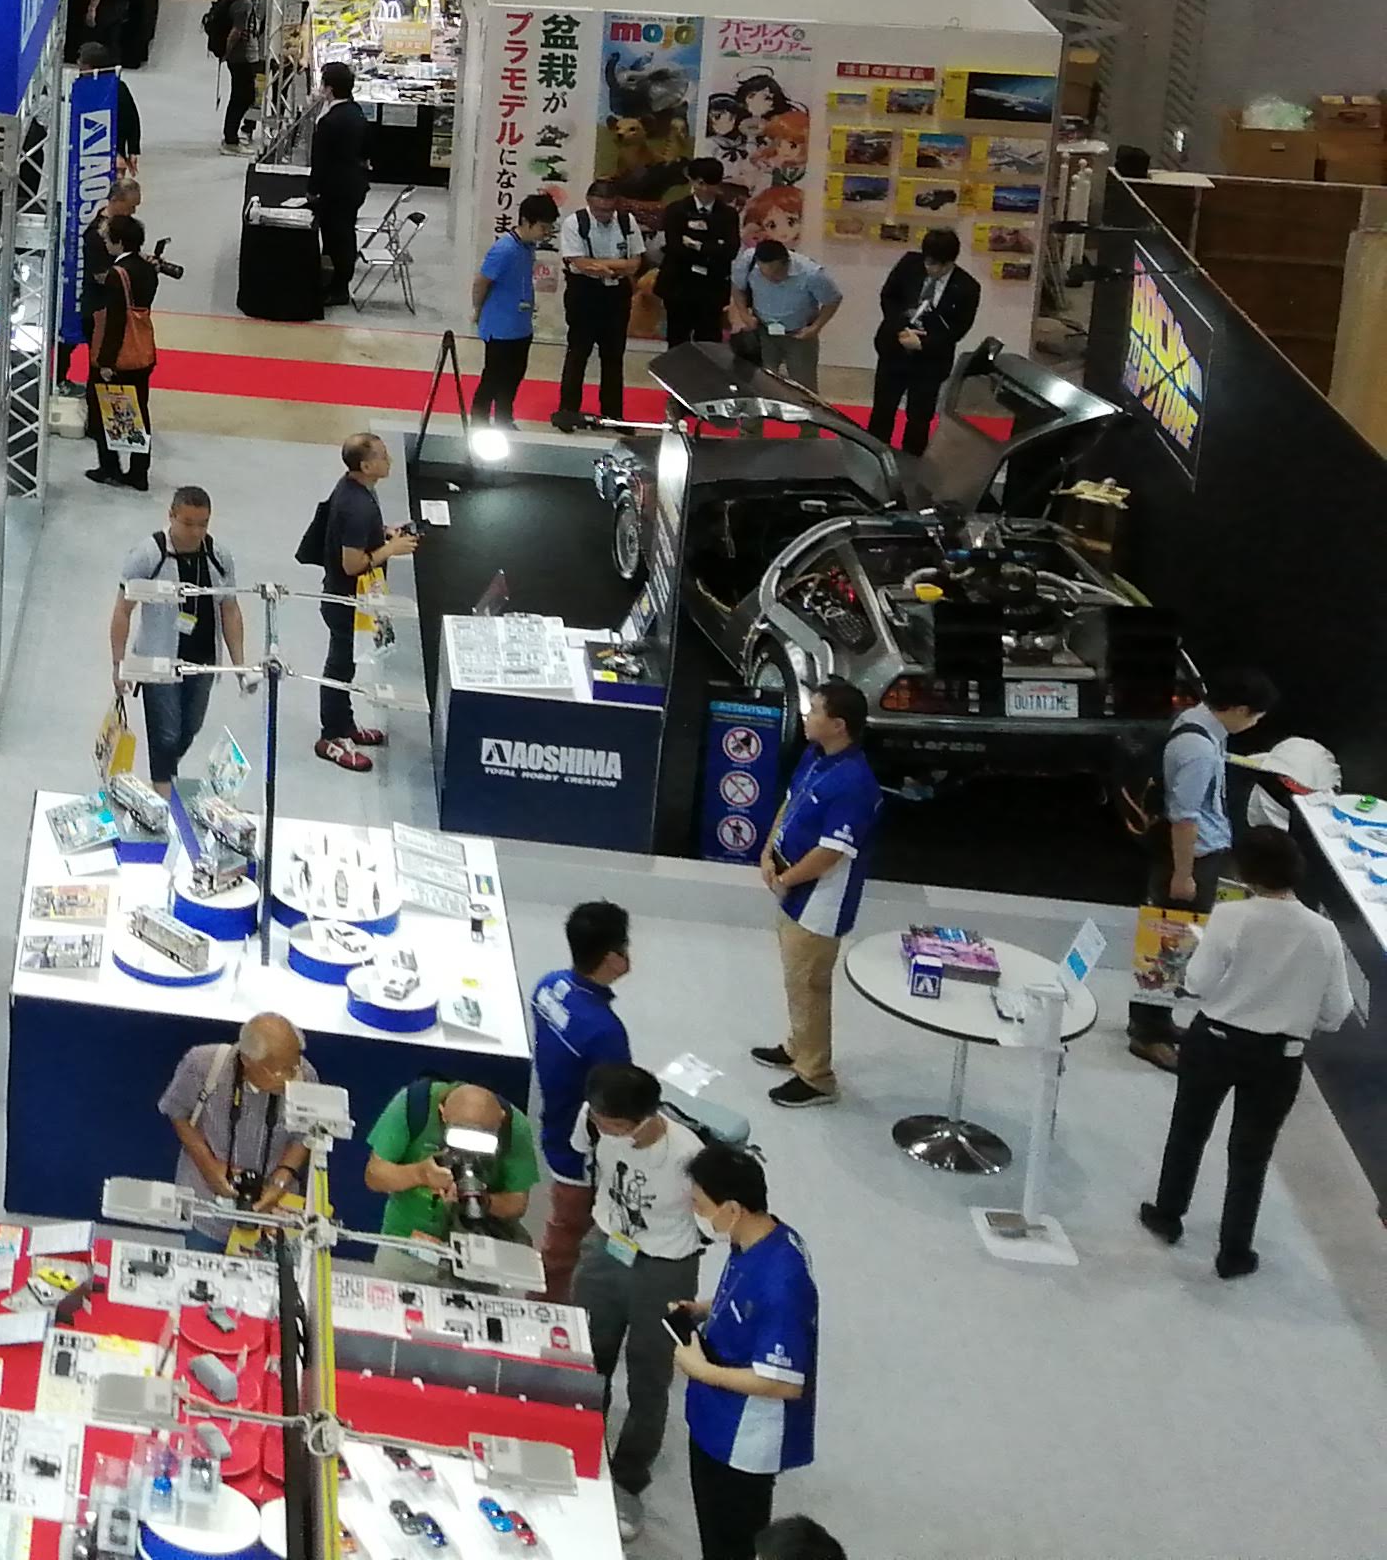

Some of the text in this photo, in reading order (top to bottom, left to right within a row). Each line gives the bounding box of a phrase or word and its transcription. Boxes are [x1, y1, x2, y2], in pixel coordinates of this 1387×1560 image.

[610, 22, 696, 49] mojo
[537, 13, 581, 115] 盆栽が
[494, 11, 534, 243] プラモデルになりま
[1014, 693, 1071, 712] OUTATIME
[511, 741, 623, 780] AOSHIMA
